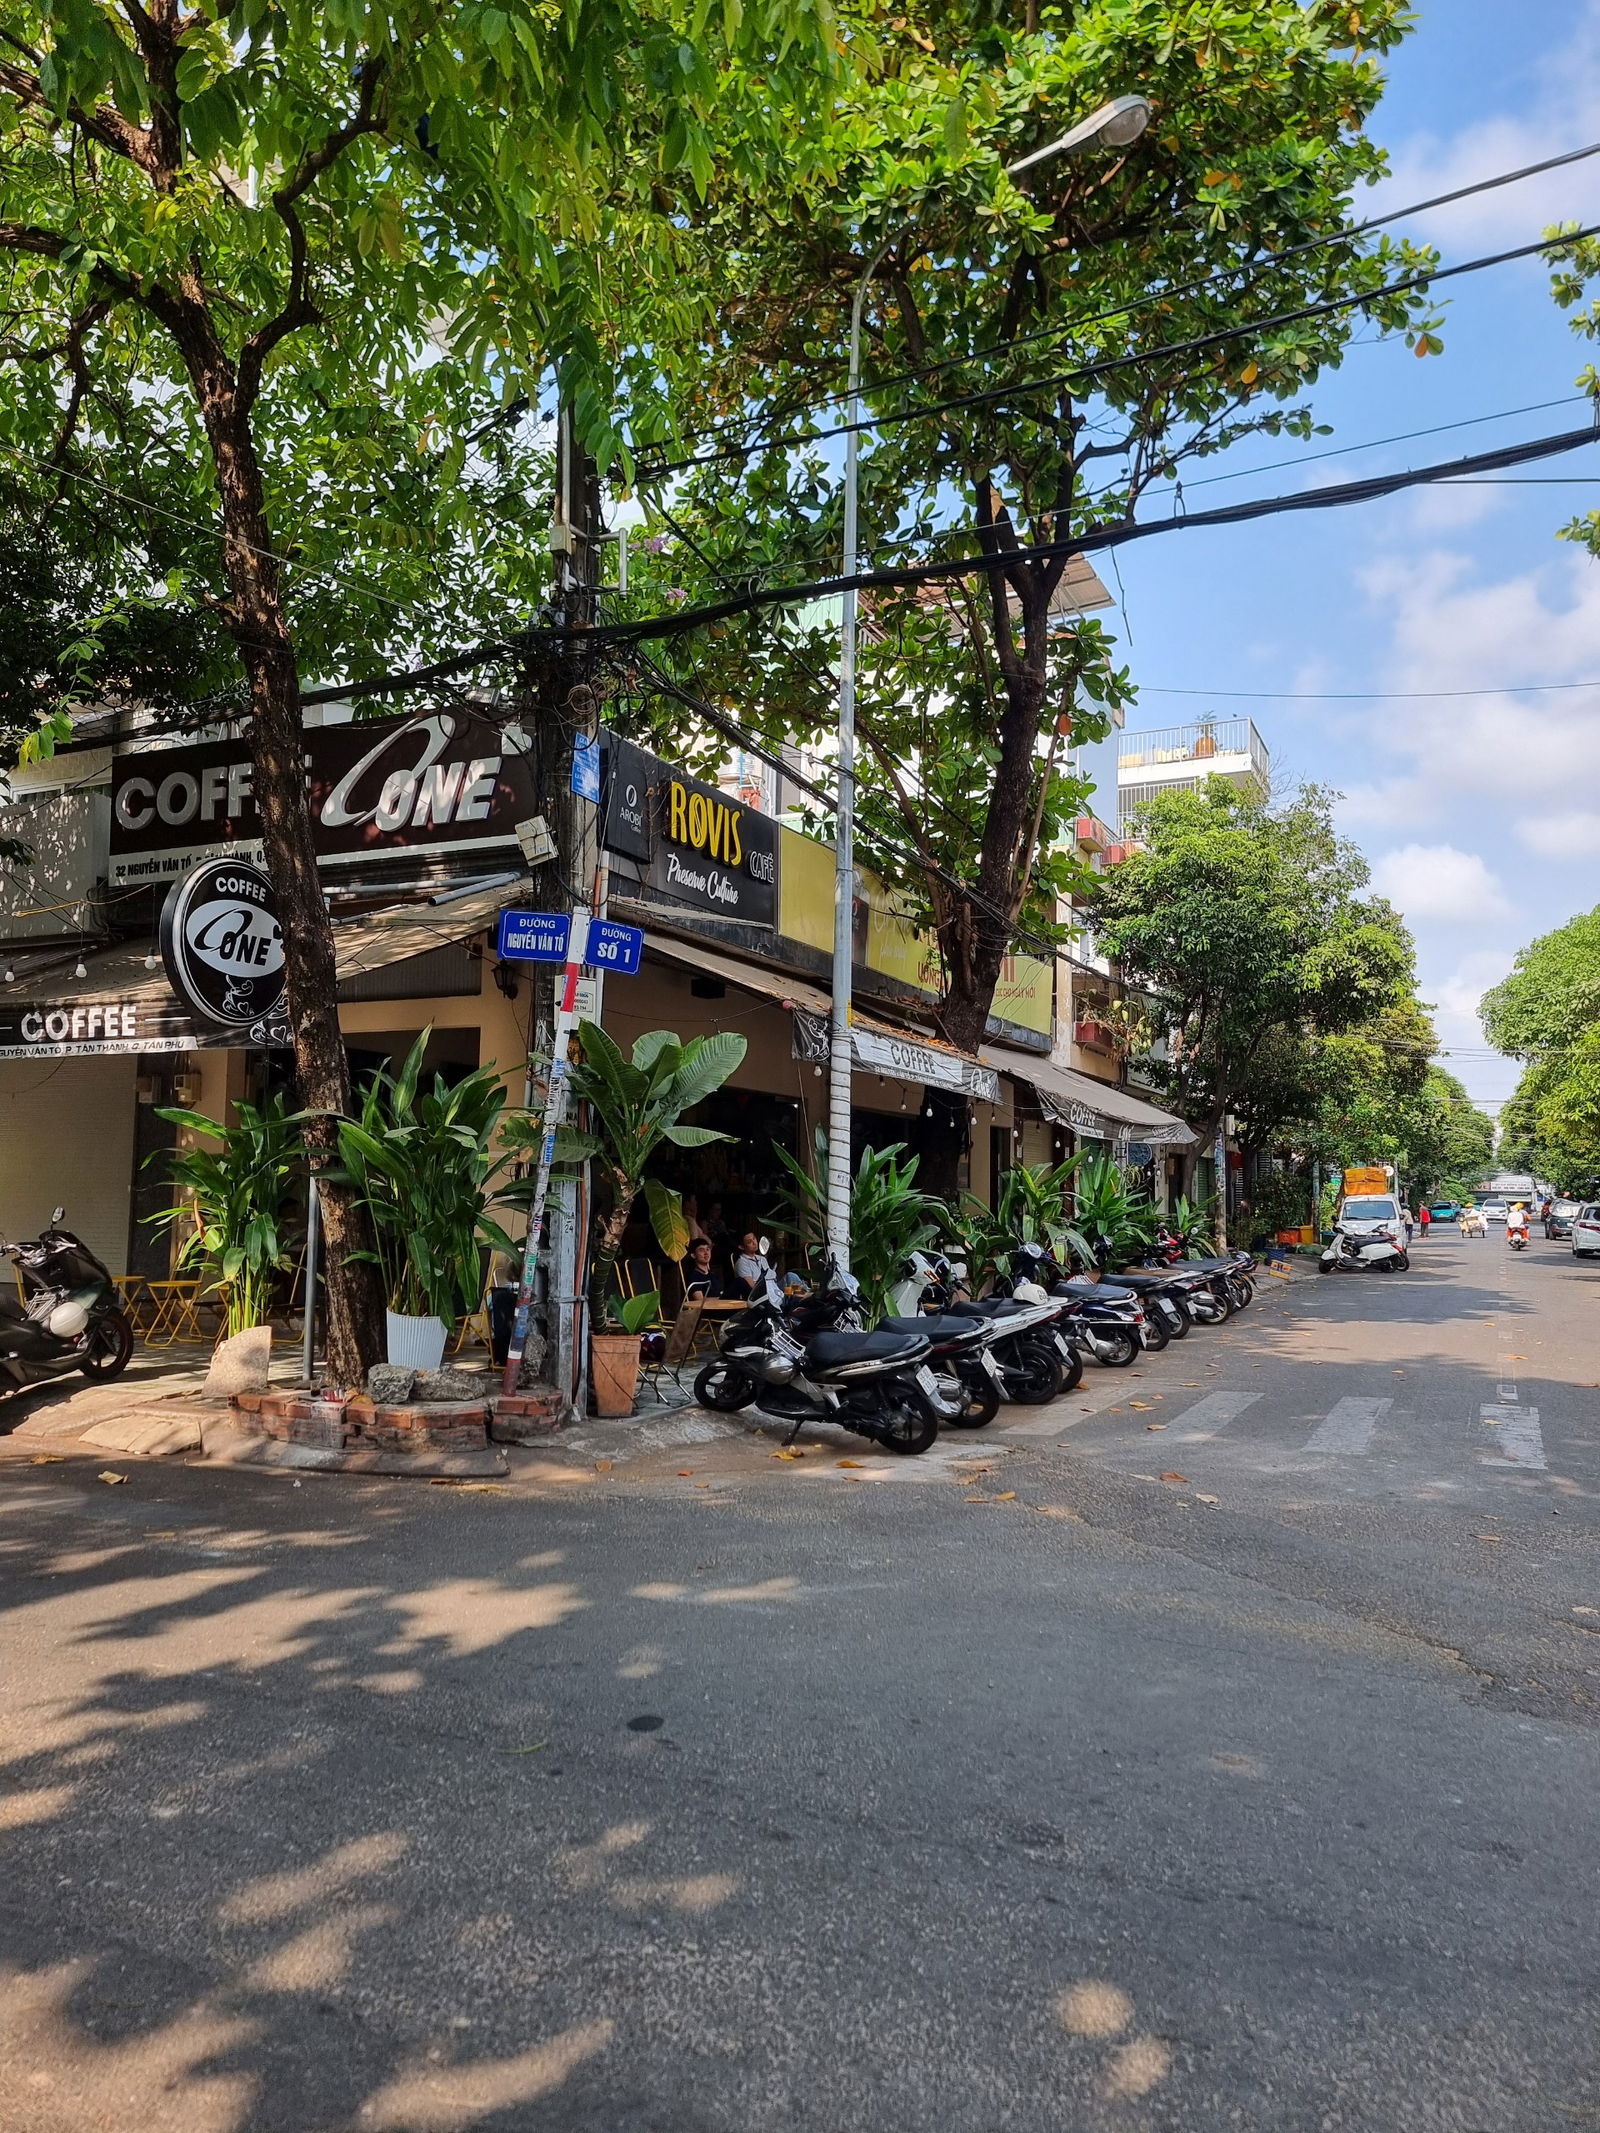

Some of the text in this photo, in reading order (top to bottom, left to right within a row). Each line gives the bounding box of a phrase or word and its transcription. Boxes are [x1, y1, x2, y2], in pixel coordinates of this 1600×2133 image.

[115, 755, 312, 830] COFF
[671, 781, 742, 866] ROVIS
[115, 865, 126, 877] 32
[162, 858, 178, 872] VĂN
[667, 853, 739, 905] Preserve Culture
[750, 851, 774, 883] CAFÉ
[215, 877, 266, 902] COFFEE
[519, 918, 556, 929] ĐƯỜNG
[601, 927, 632, 942] ĐƯỜNG
[507, 930, 565, 952] NGUYỄN VĂN TỐ
[597, 941, 631, 963] SỐ 1
[21, 1005, 137, 1042] COFFEE
[890, 1043, 936, 1074] COFFEE
